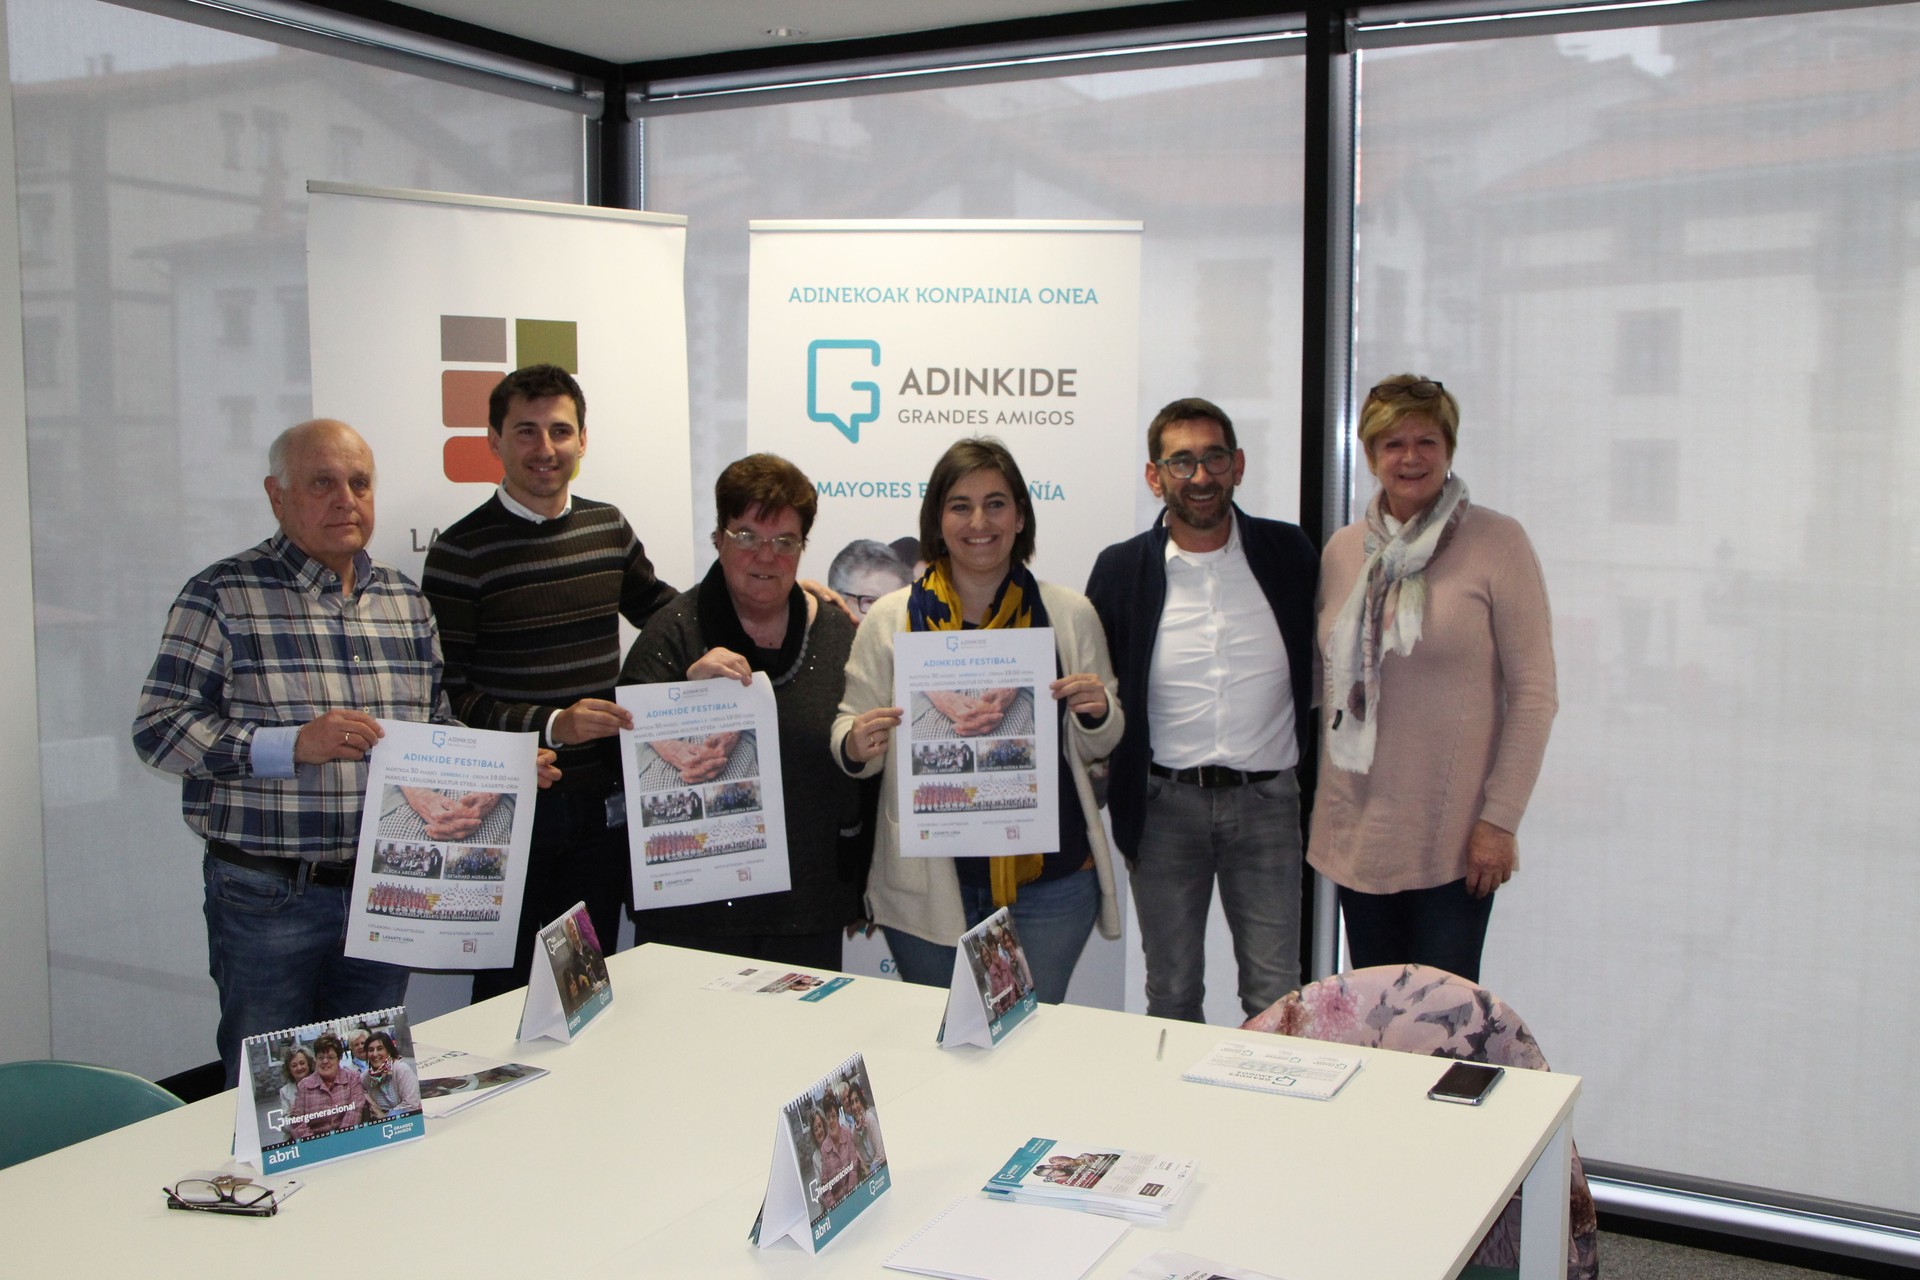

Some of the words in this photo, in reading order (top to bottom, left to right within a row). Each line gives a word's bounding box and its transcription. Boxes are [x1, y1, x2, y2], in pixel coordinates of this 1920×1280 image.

[789, 287, 909, 303] ADINEKOAK
[917, 288, 1032, 304] KONPAINIA
[1039, 288, 1098, 304] ONEA
[899, 368, 1077, 397] ADINKIDE
[898, 410, 988, 424] GRANDES
[996, 411, 1074, 425] AMIGOS
[817, 482, 911, 497] MAYORES
[923, 659, 966, 668] ADINKIDE
[970, 657, 1017, 666] FESTIBALA
[647, 706, 688, 719] ADINKIDE
[692, 702, 738, 713] FESTIBALA
[403, 753, 450, 764] ADINKIDE
[454, 757, 505, 769] FESTIBALA
[285, 1102, 355, 1125] intergeneracional
[394, 1122, 414, 1130] GRANDES
[269, 1146, 300, 1164] abril
[815, 1217, 831, 1240] abril
